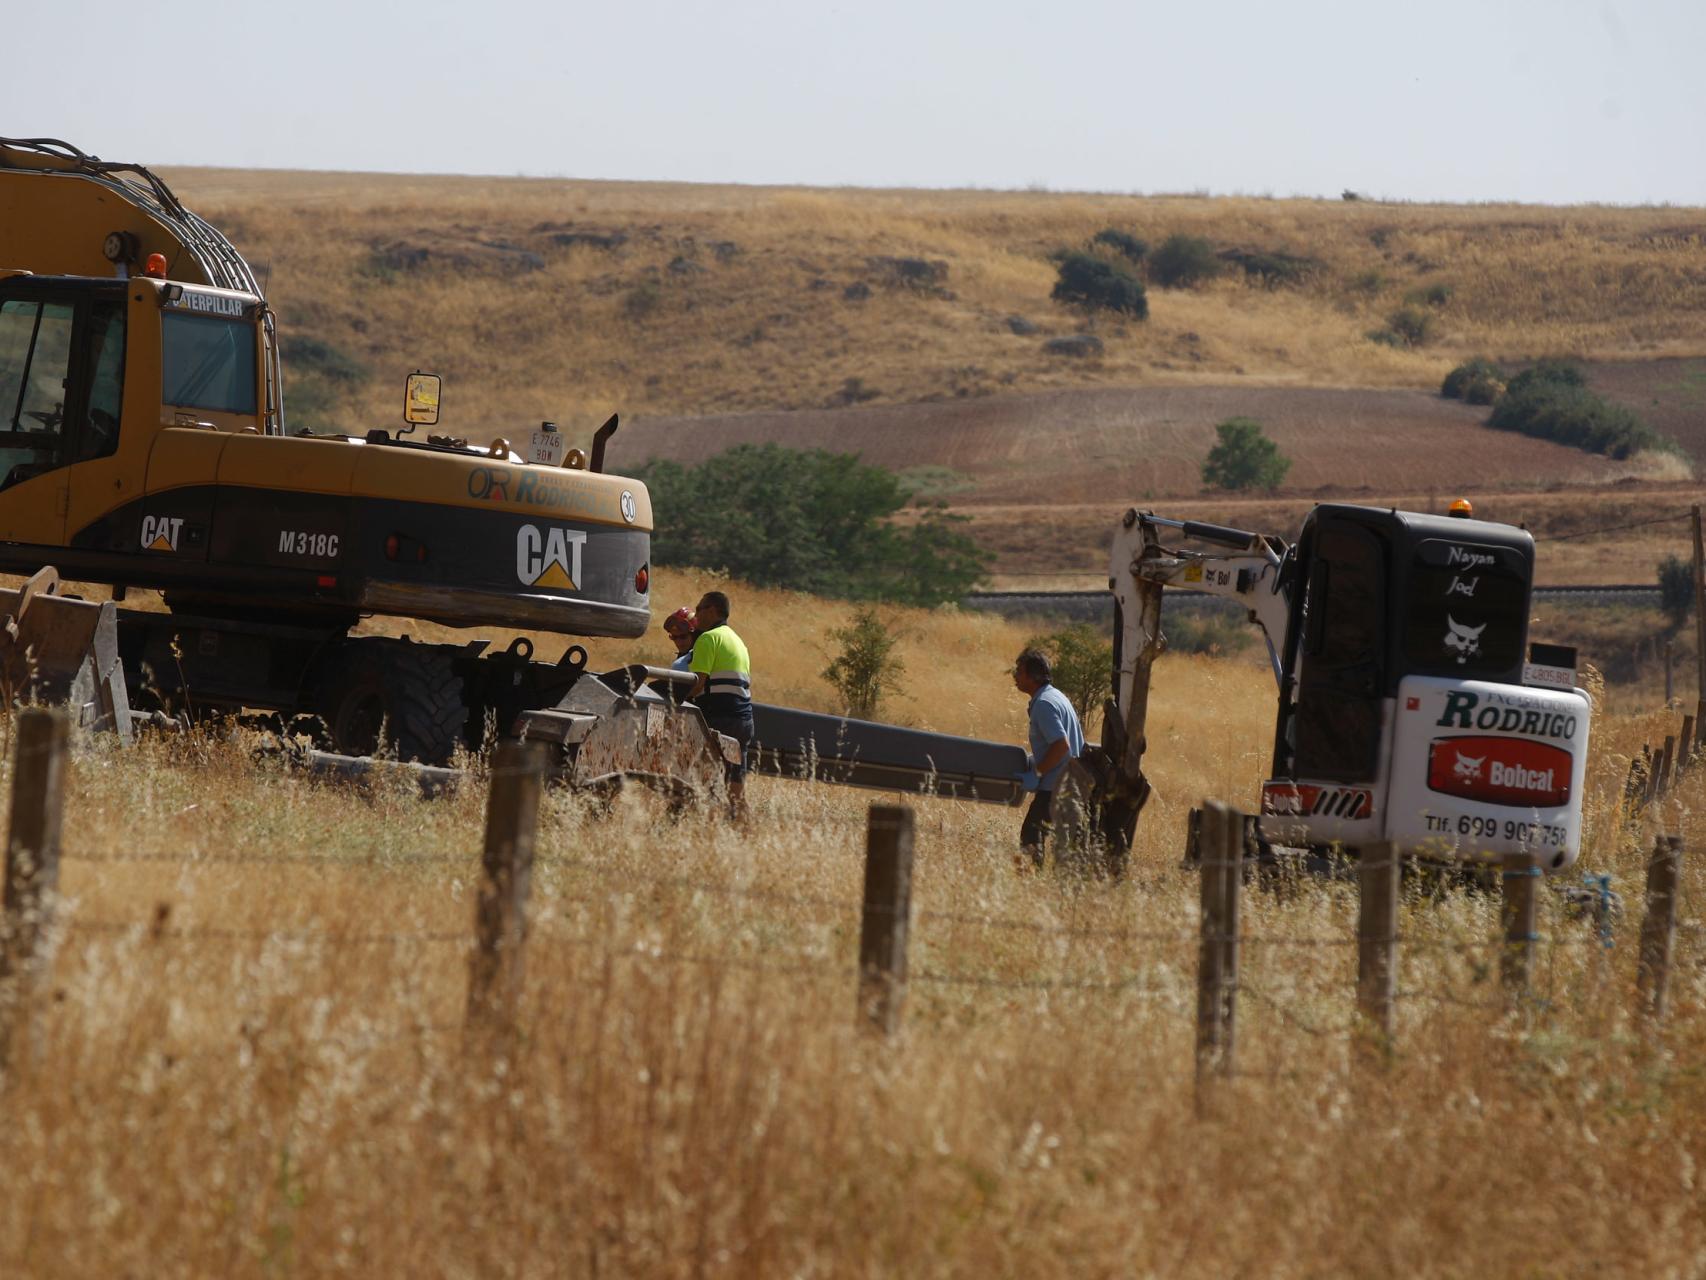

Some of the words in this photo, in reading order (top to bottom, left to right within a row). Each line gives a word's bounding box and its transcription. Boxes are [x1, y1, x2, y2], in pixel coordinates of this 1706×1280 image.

[622, 496, 635, 520] 30
[140, 515, 184, 552] CAT
[516, 523, 587, 591] CAT
[1447, 546, 1496, 571] Nayan
[1436, 690, 1577, 740] RODRIGO
[1490, 761, 1554, 792] Bobcat
[1457, 815, 1497, 838] 699
[1504, 820, 1538, 844] 907
[1542, 824, 1567, 848] 758
